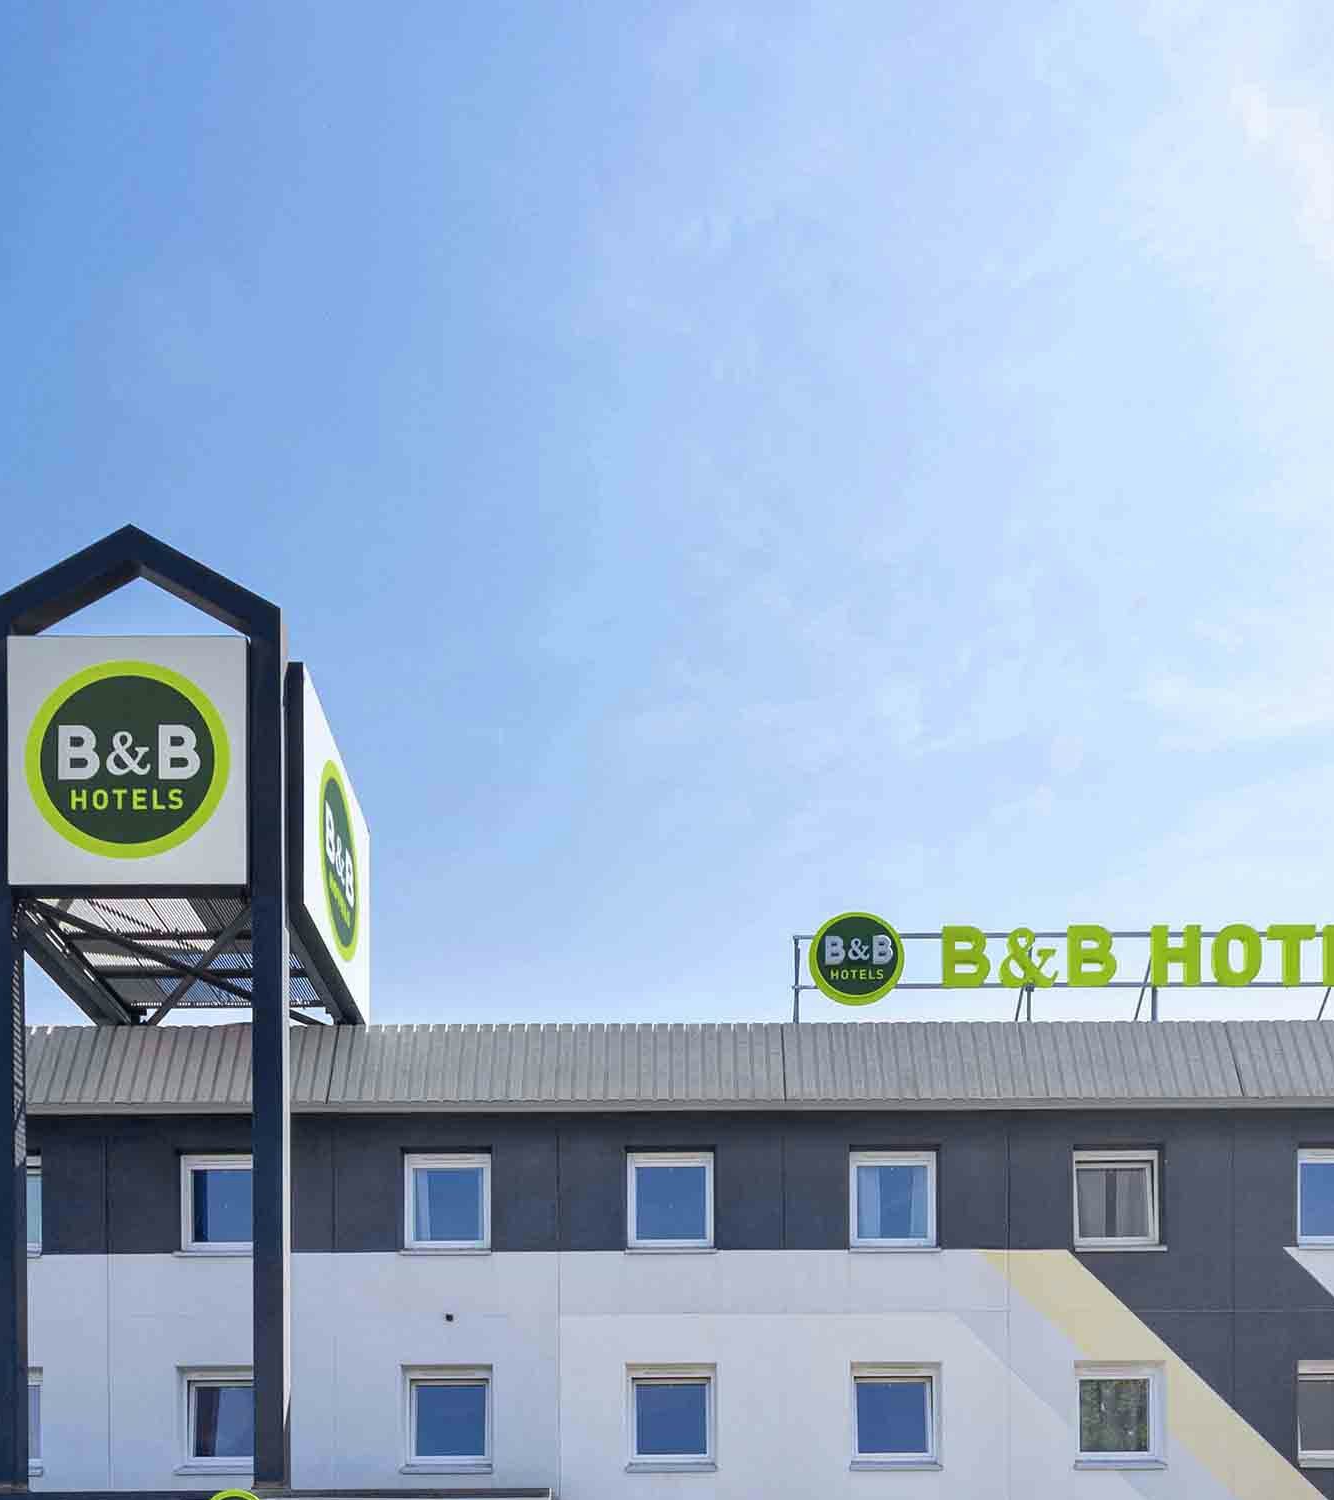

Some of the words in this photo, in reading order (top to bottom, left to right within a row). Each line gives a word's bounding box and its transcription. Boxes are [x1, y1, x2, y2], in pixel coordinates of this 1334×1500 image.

[57, 724, 201, 781] B&B
[70, 788, 185, 811] HOTELS
[324, 799, 354, 909] B&B
[824, 934, 894, 966] B&B
[941, 924, 1118, 988] B&B
[830, 968, 885, 980] HOTELS
